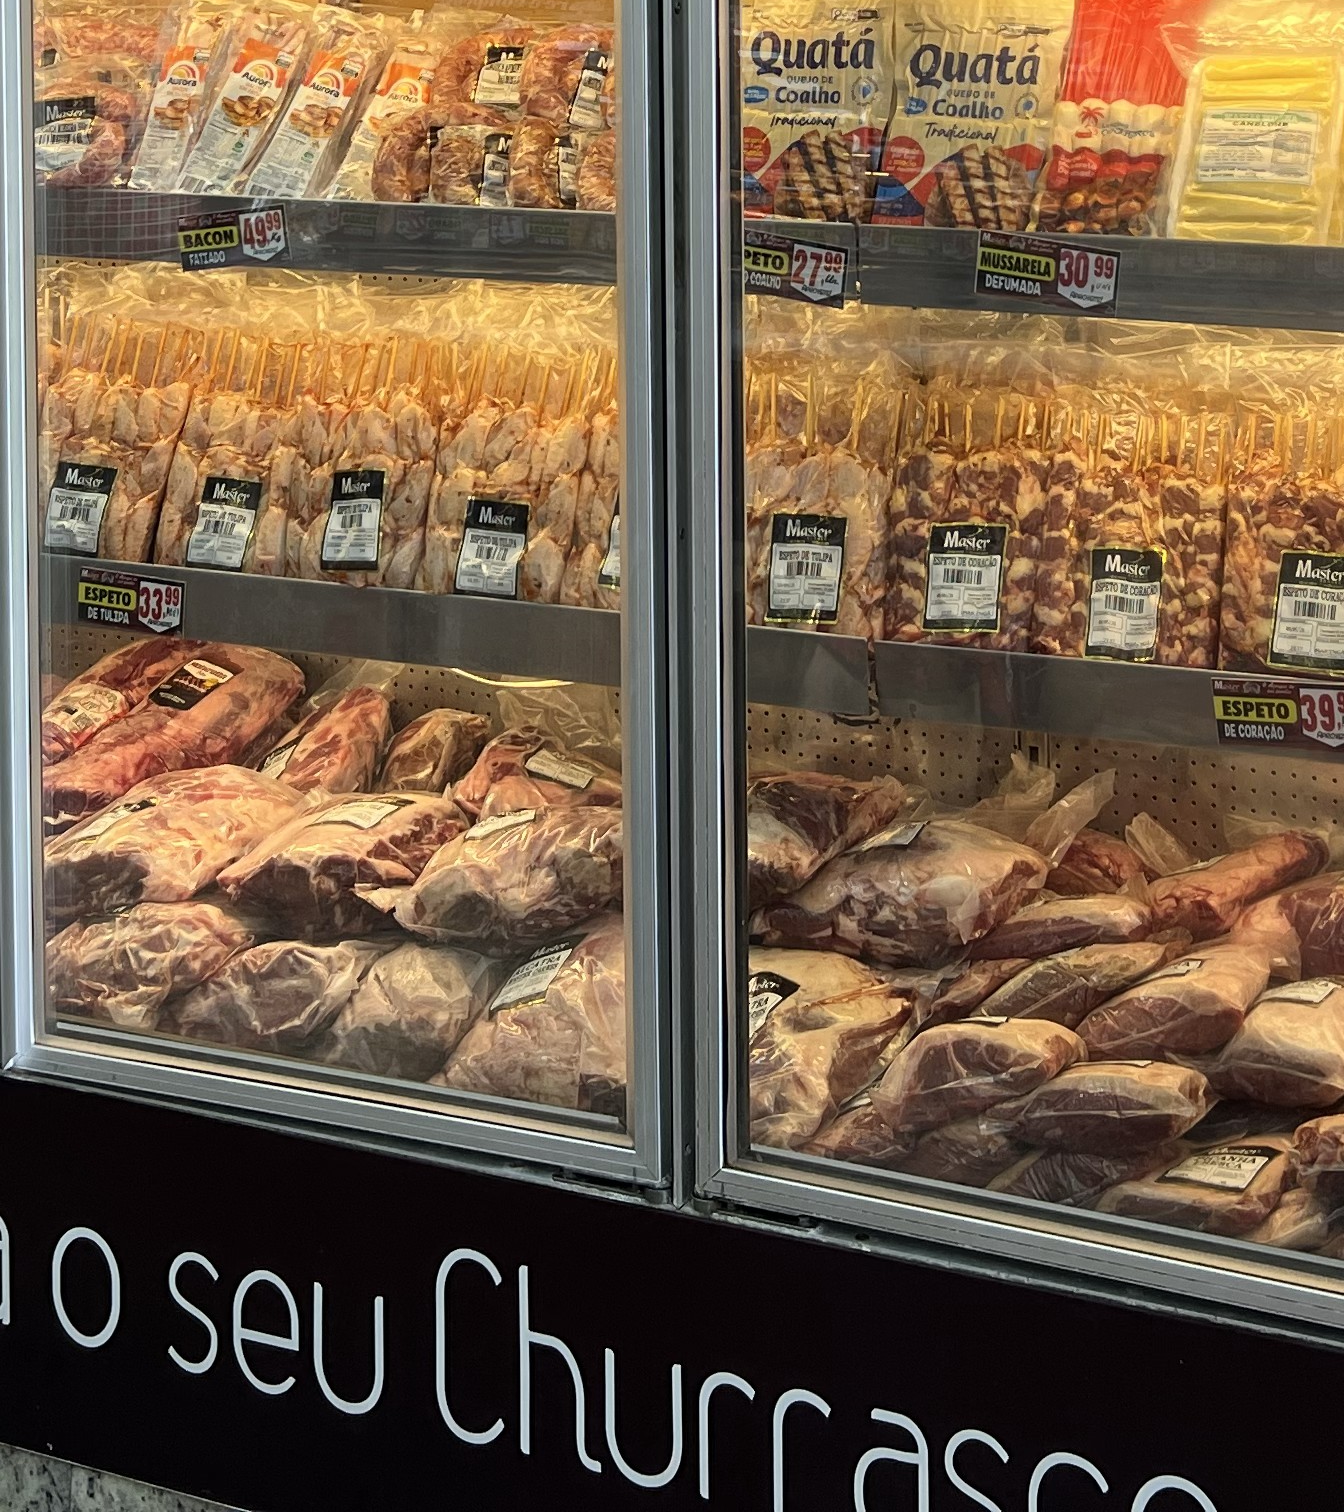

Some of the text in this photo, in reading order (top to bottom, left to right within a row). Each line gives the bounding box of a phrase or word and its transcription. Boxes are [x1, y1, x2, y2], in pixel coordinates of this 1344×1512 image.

[751, 28, 875, 76] Quatá
[910, 43, 1041, 89] Quatá
[774, 87, 841, 105] Coalho
[932, 99, 1004, 120] Coalho
[183, 229, 234, 248] BACON
[189, 252, 225, 264] FATIADO
[980, 251, 1051, 278] MUSSARELA
[750, 274, 781, 289] COALHO
[985, 275, 1041, 296] DEFUMADA
[85, 586, 131, 606] ESPETO
[88, 606, 129, 624] DE TULIPA
[1223, 700, 1290, 719] ESPETO
[1224, 722, 1284, 740] DE CORAÇÃO
[52, 1225, 121, 1350] o
[166, 1250, 385, 1417] seu
